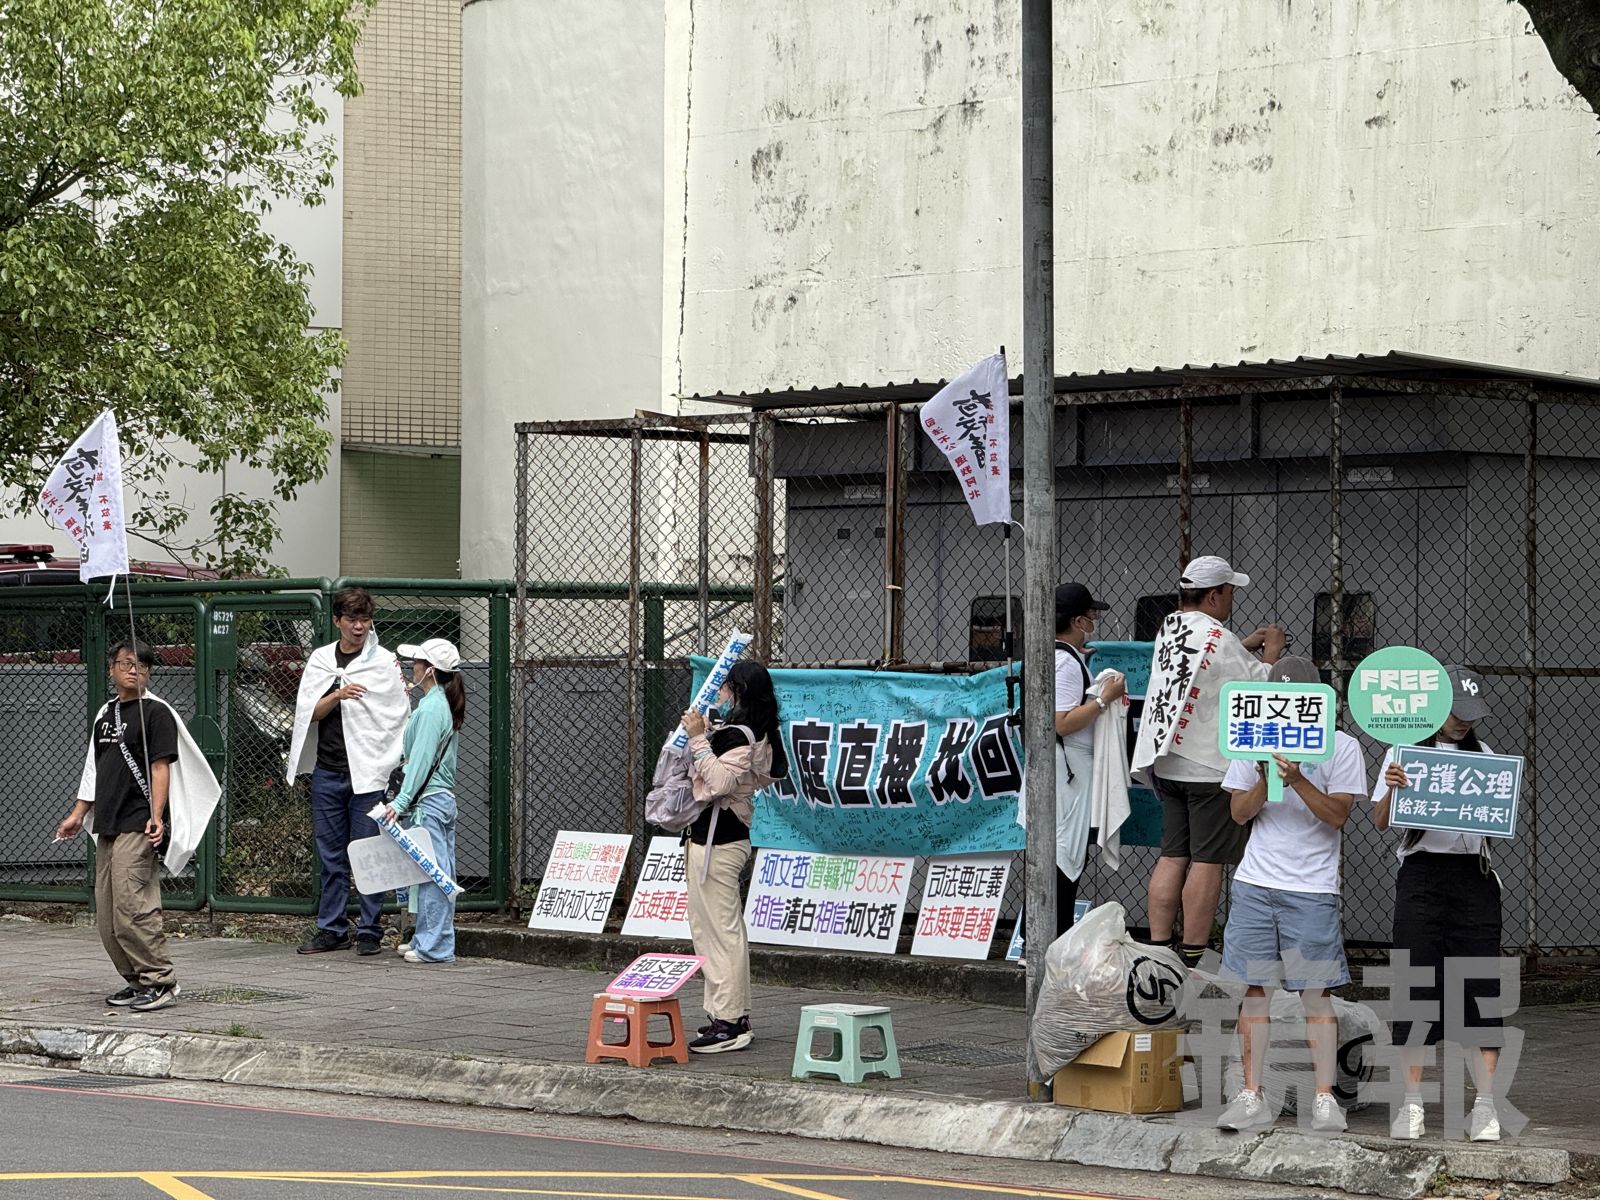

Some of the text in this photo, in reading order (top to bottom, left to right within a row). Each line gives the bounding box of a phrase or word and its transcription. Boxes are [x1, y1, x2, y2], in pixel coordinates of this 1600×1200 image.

[1360, 669, 1440, 691] FREE
[1231, 693, 1324, 723] 柯文哲
[1229, 721, 1324, 750] 清清白白
[1404, 760, 1513, 800] 守護公理
[1397, 797, 1510, 824] 給孩子一片晴天!
[758, 853, 906, 895] 柯文哲遭羈押365天
[928, 865, 1005, 899] 司法要正義
[536, 886, 613, 922] 釋放柯文哲
[751, 895, 897, 940] 相信清白相信柯文哲
[918, 905, 996, 942] 法庭要直播
[615, 972, 682, 990] 清清白白
[632, 957, 694, 976] 柯文哲
